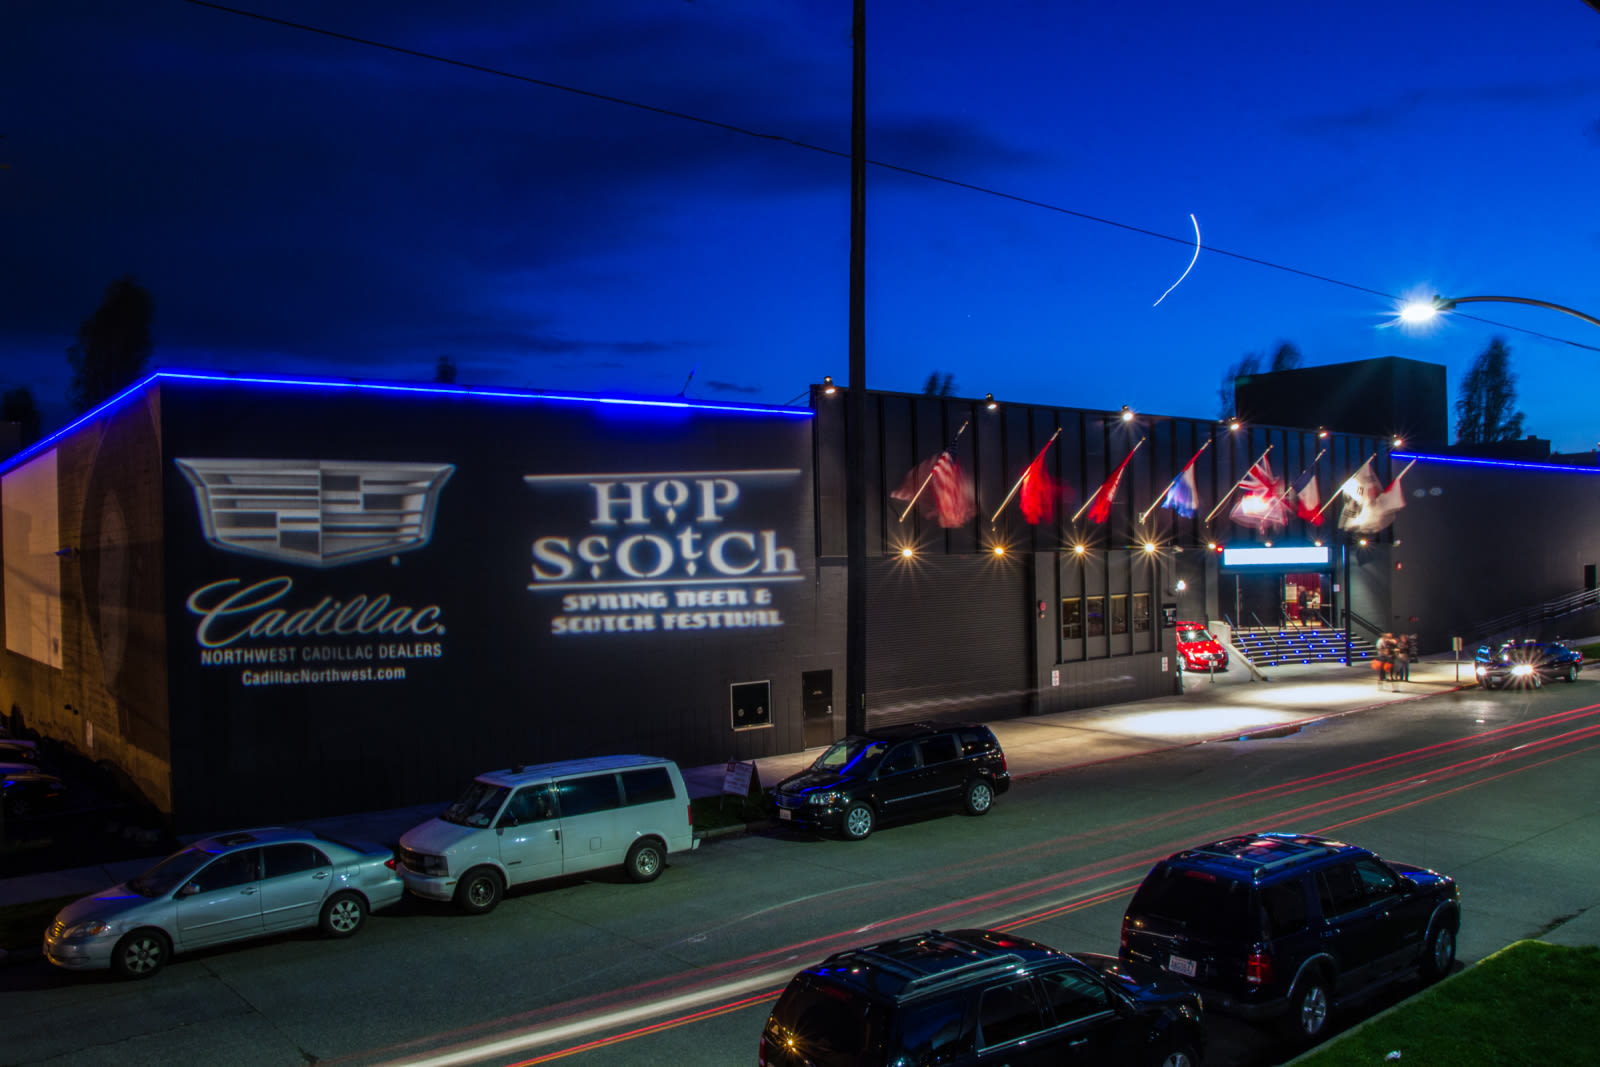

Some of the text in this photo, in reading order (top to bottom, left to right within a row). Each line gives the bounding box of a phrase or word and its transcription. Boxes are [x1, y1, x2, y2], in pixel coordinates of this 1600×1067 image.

[186, 576, 441, 648] Cadillac
[562, 591, 668, 612] SPRING
[675, 589, 748, 608] BEER
[551, 610, 785, 635] SCOTCH FESTIVAL
[200, 643, 442, 665] NORTHWEST CADILLAC DEALERS
[241, 667, 406, 686] CadillacNorthwest.com
